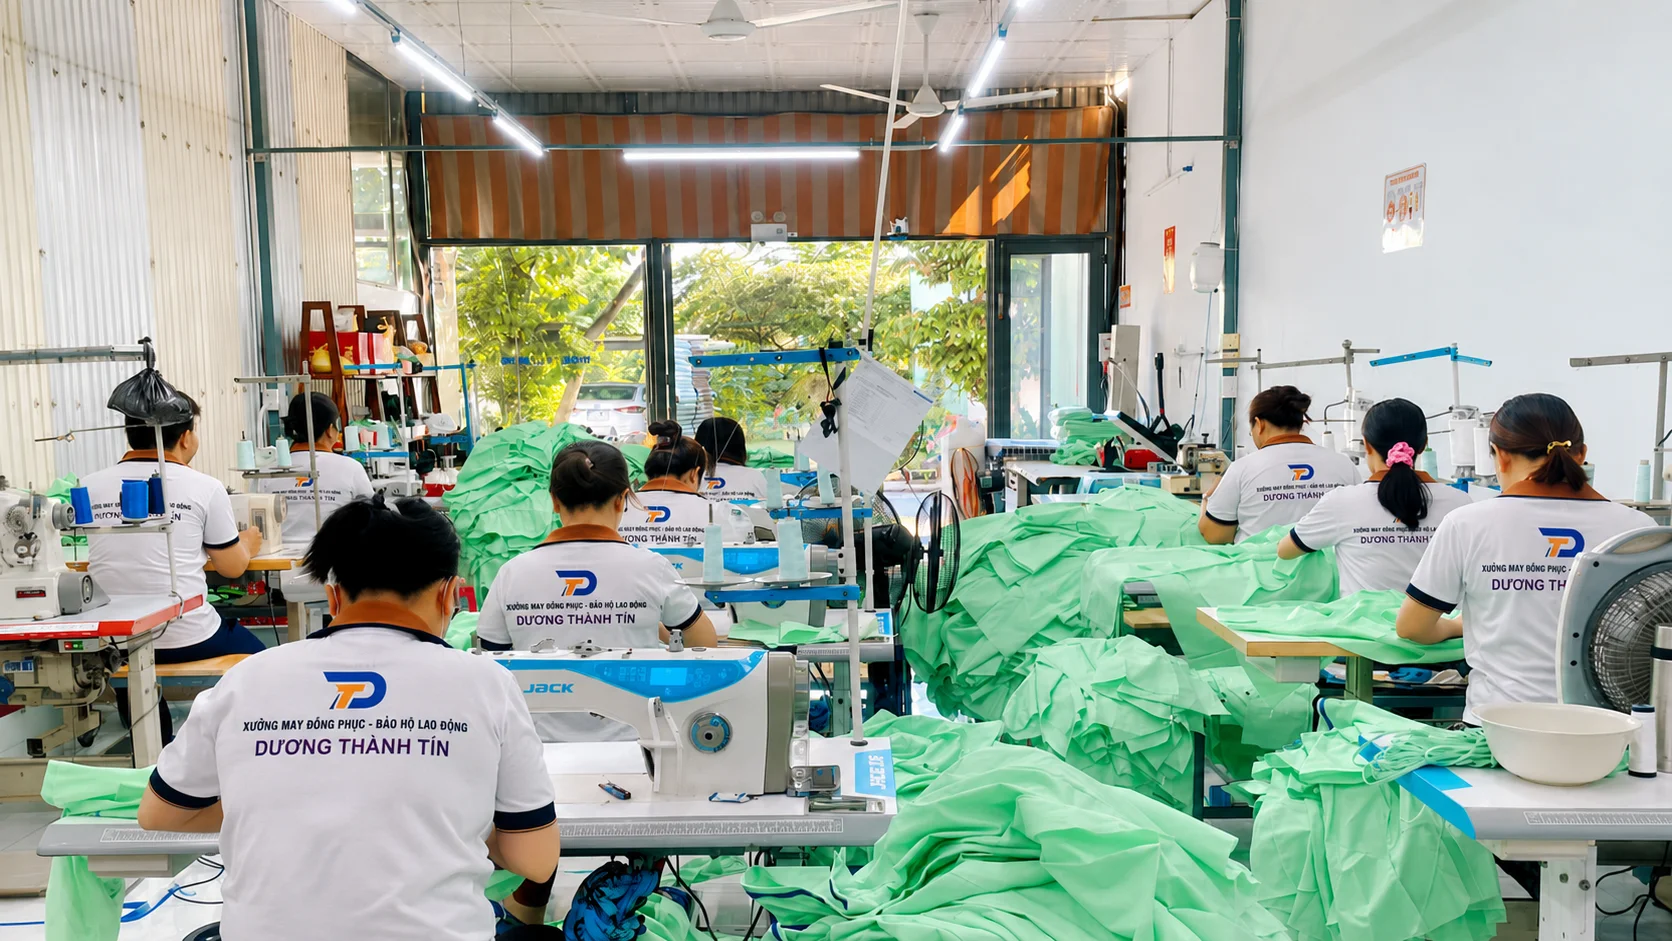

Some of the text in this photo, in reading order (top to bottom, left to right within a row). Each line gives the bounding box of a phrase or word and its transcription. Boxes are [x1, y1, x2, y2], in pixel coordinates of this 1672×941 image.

[1492, 579, 1544, 591] DƯƠNG
[516, 611, 635, 626] DƯƠNG THÀNH TÍN
[281, 719, 304, 730] MAY
[338, 719, 366, 732] PHỤC
[400, 716, 415, 732] HỘ
[417, 719, 437, 730] LAO
[440, 718, 468, 733] ĐỘNG
[255, 734, 449, 757] DƯƠNG THÀNH TÍN
